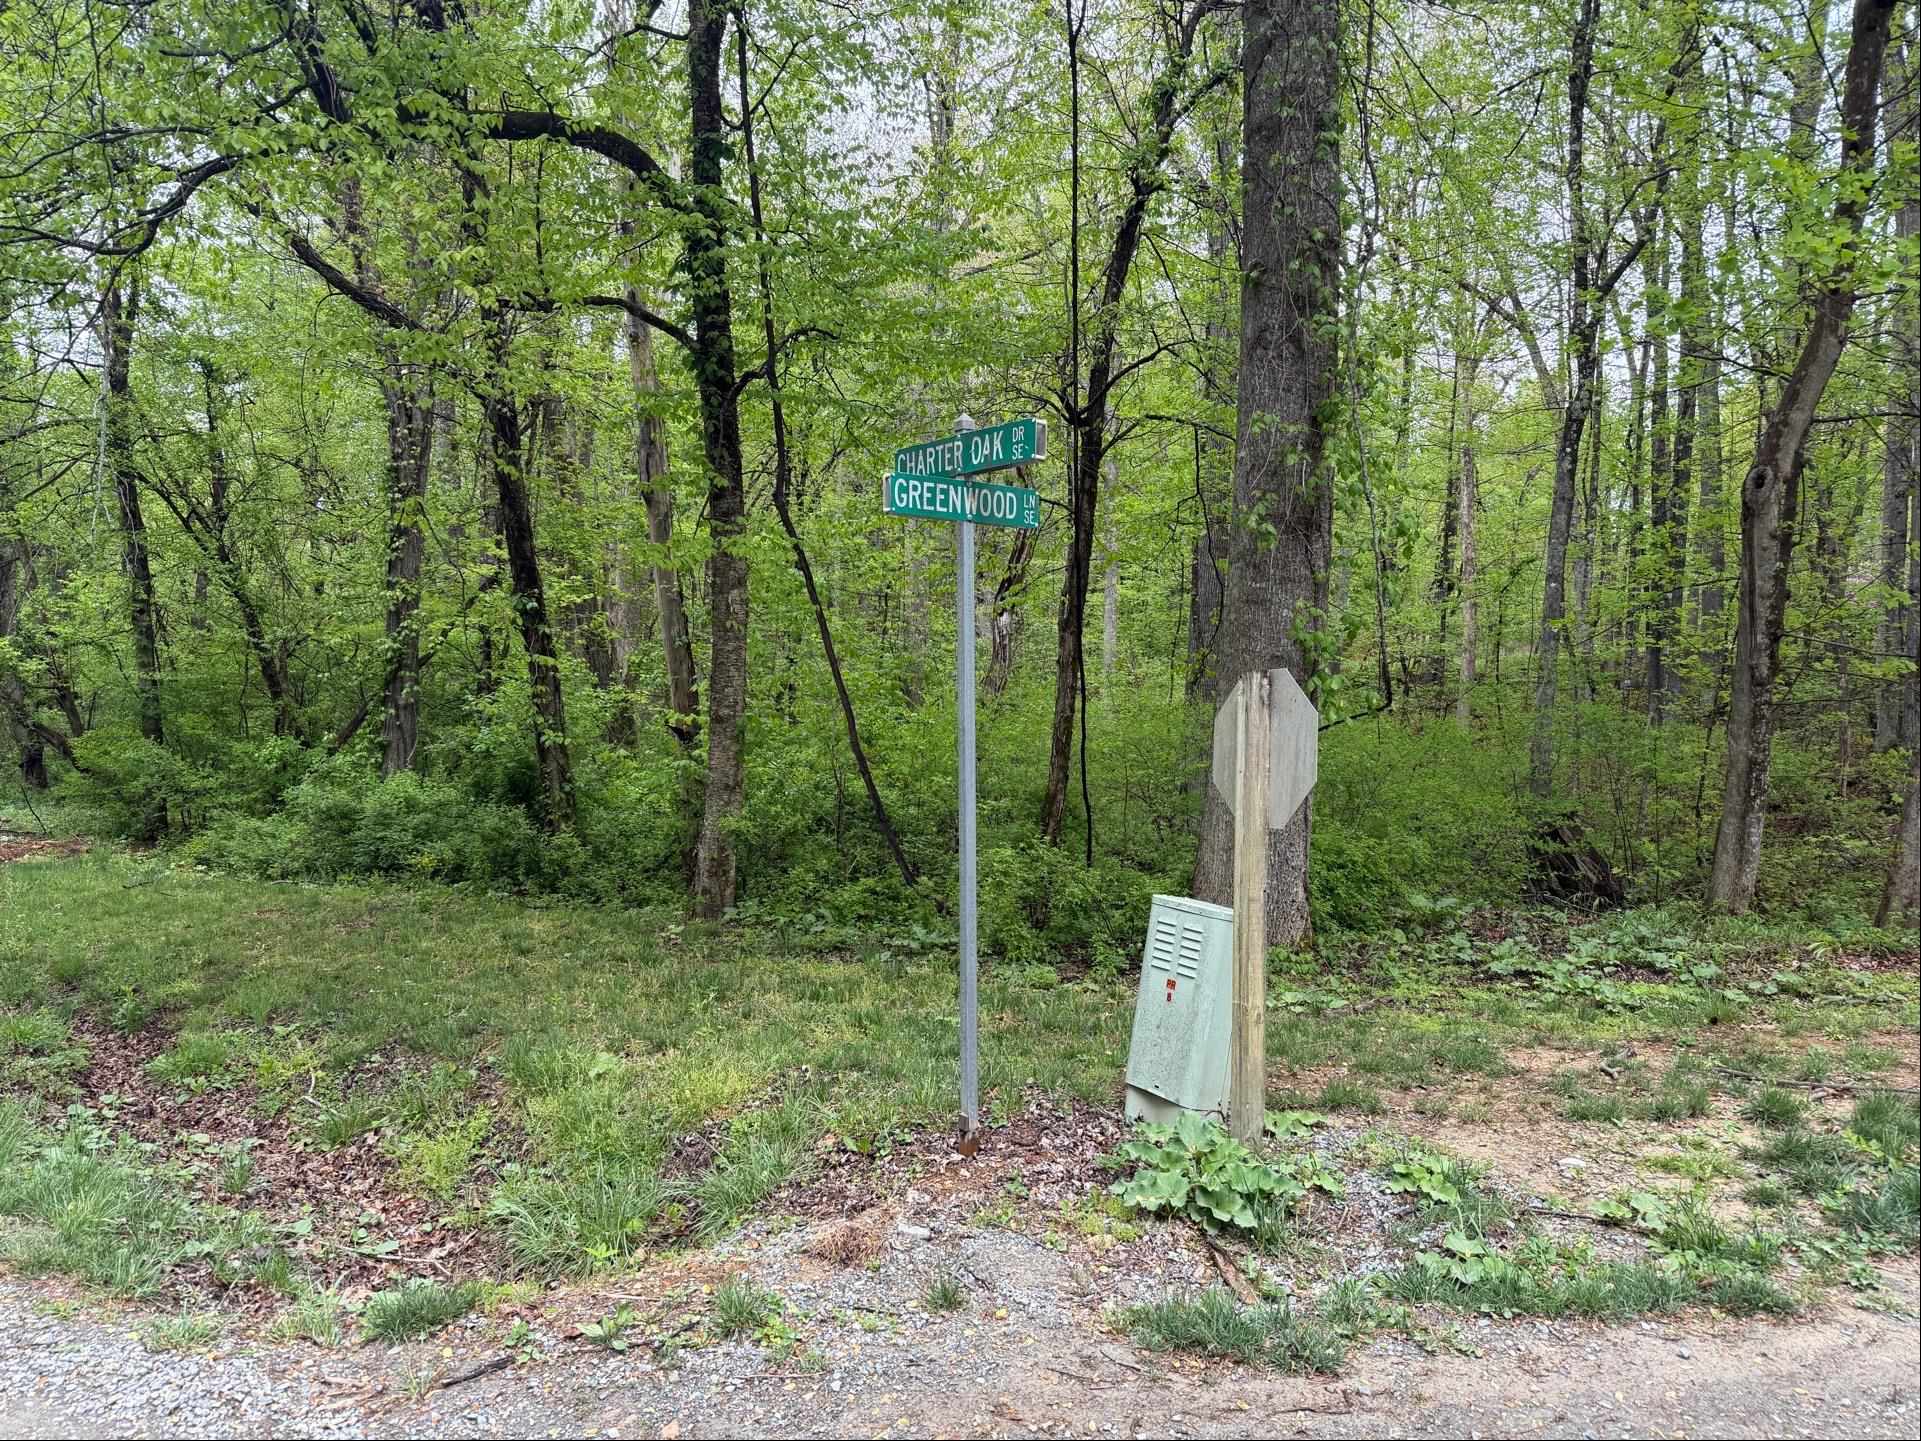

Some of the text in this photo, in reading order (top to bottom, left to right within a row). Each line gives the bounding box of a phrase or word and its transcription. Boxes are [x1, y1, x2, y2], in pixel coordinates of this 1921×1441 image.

[897, 425, 1025, 475] CHARTER OAK DR
[1011, 442, 1024, 460] SE
[894, 478, 1036, 519] GREENWOOD LN
[1023, 510, 1035, 525] SE
